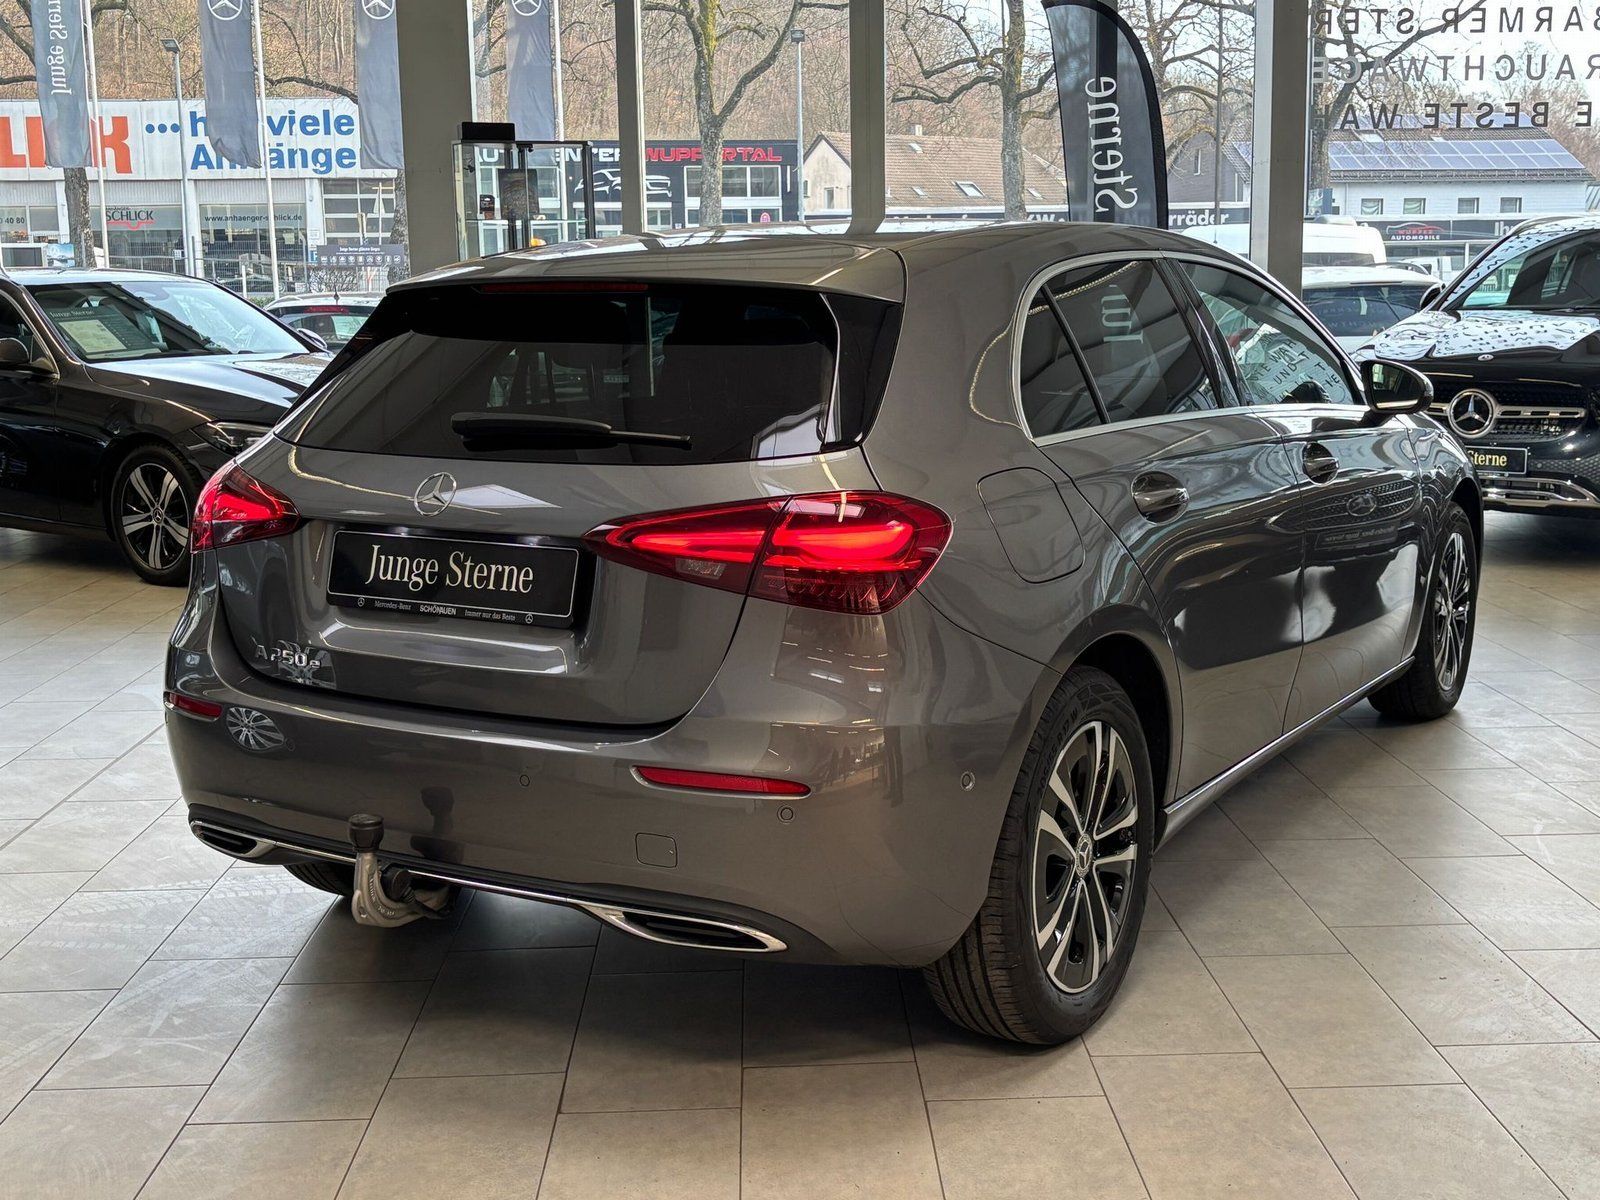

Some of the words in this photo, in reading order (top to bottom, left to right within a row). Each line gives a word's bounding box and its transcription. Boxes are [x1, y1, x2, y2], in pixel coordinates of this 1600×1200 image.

[267, 109, 355, 136] viele
[645, 147, 782, 161] WUPPRTAL
[105, 210, 154, 221] SCHLICK
[204, 213, 303, 222] www.anhaenger-shlick.de
[365, 544, 439, 592] Junge
[445, 551, 534, 593] Sterne
[374, 600, 412, 611] Mercedes-Benz
[464, 609, 481, 617] Immer
